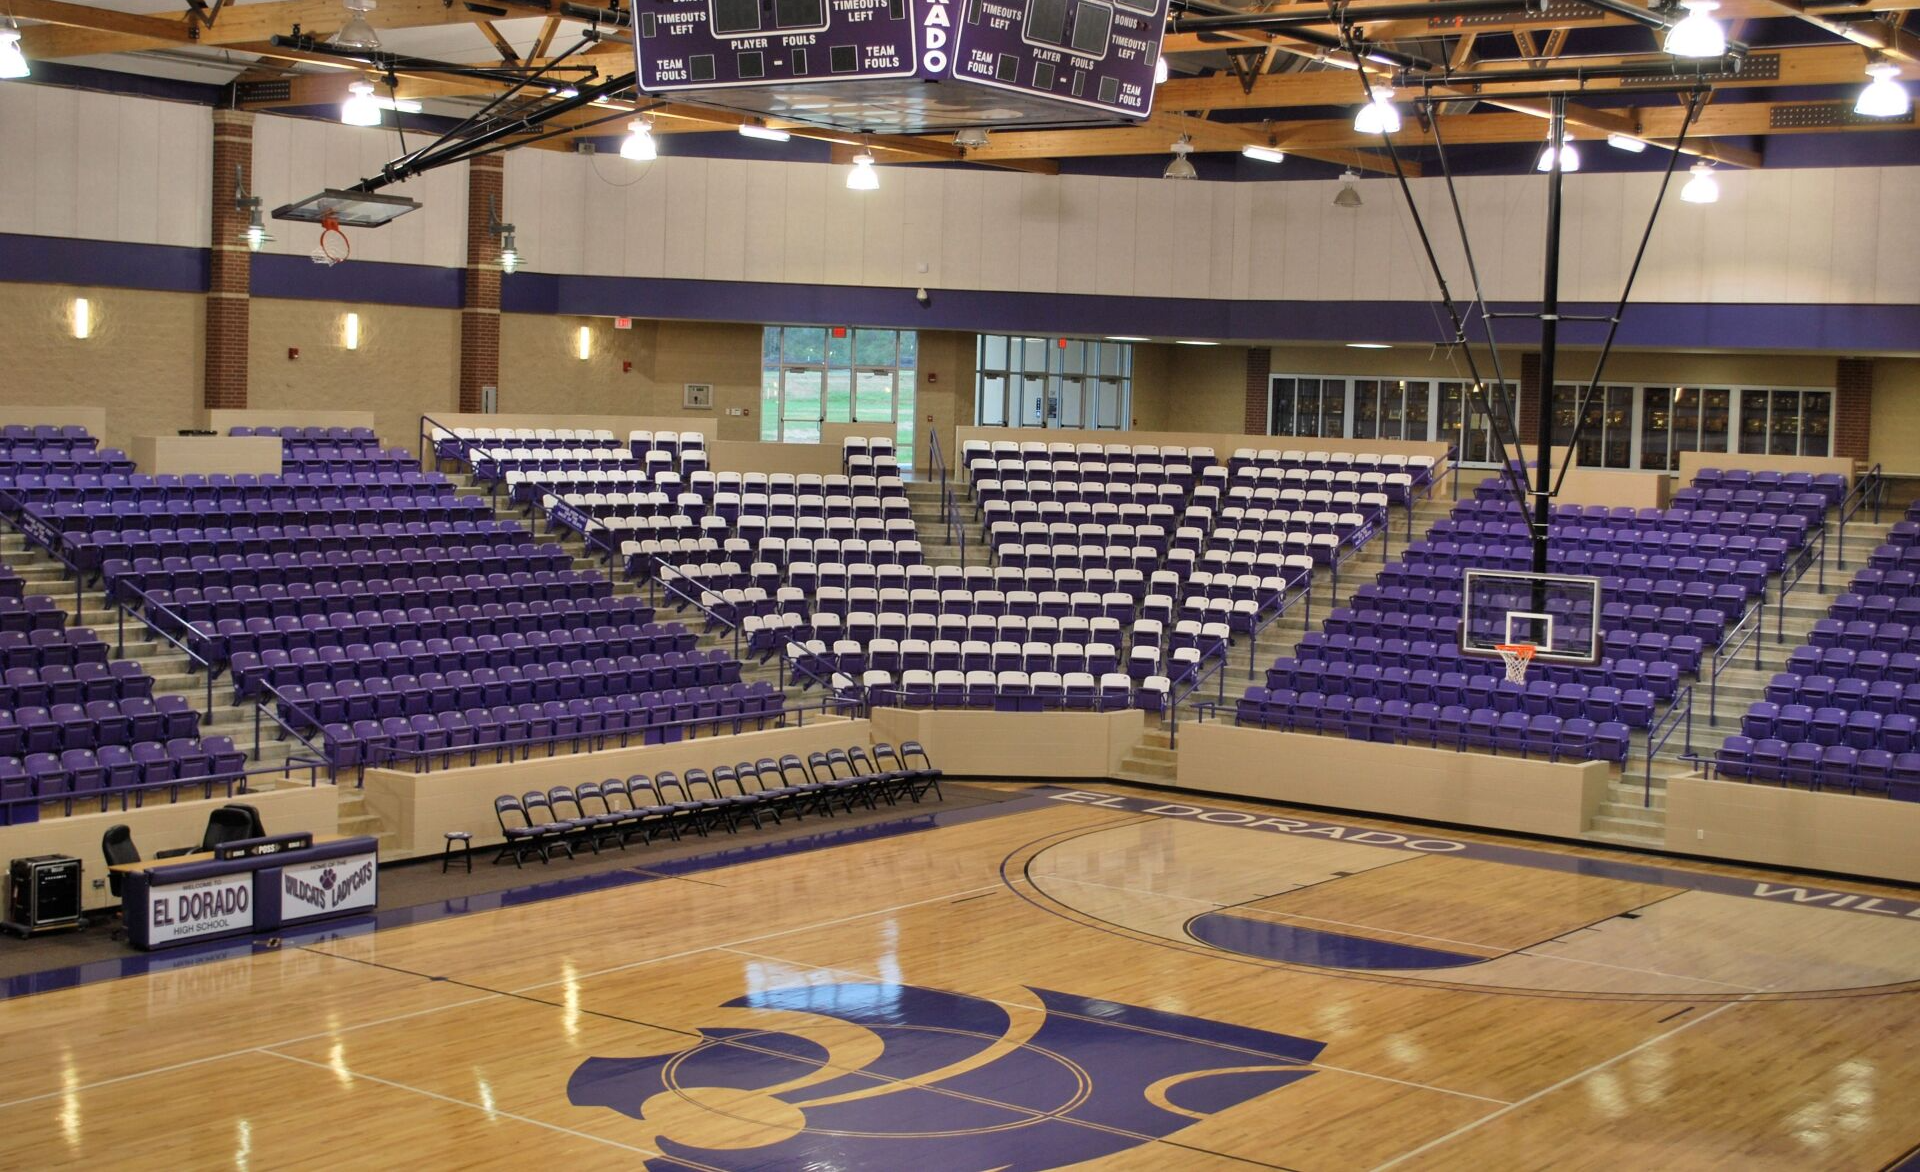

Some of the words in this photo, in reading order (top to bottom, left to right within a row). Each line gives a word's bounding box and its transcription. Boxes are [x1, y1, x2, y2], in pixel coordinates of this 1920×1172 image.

[833, 0, 888, 11] TIMEOUTS
[983, 2, 1022, 21] TIMEOUTS
[657, 12, 706, 24] TIMEOUTS
[848, 11, 874, 22] LEFT
[1114, 14, 1138, 29] BONUS
[671, 24, 694, 35] LEFT
[990, 17, 1010, 31] LEFT
[731, 38, 768, 50] PLAYER
[782, 34, 816, 46] FOULS
[923, 0, 951, 73] ADO
[1112, 34, 1146, 52] TIMEOUTS
[866, 45, 895, 57] TEAM
[971, 48, 993, 64] TEAM
[1118, 48, 1135, 60] LEFT
[657, 59, 683, 70] TEAM
[864, 57, 900, 69] FOULS
[1033, 48, 1061, 63] PLAYER
[1070, 56, 1094, 70] FOULS
[967, 61, 993, 75] FOULS
[656, 70, 687, 81] FOULS
[1122, 83, 1141, 96] TEAM
[1119, 94, 1141, 107] FOULS
[1047, 790, 1127, 809] EL
[1142, 803, 1468, 853] DORADO
[182, 881, 213, 890] WELCOME
[285, 874, 326, 910] WILDCATS
[153, 898, 174, 927] EL
[179, 885, 249, 923] DORADO
[173, 924, 194, 935] HIGH
[196, 919, 230, 932] SCHOOL
